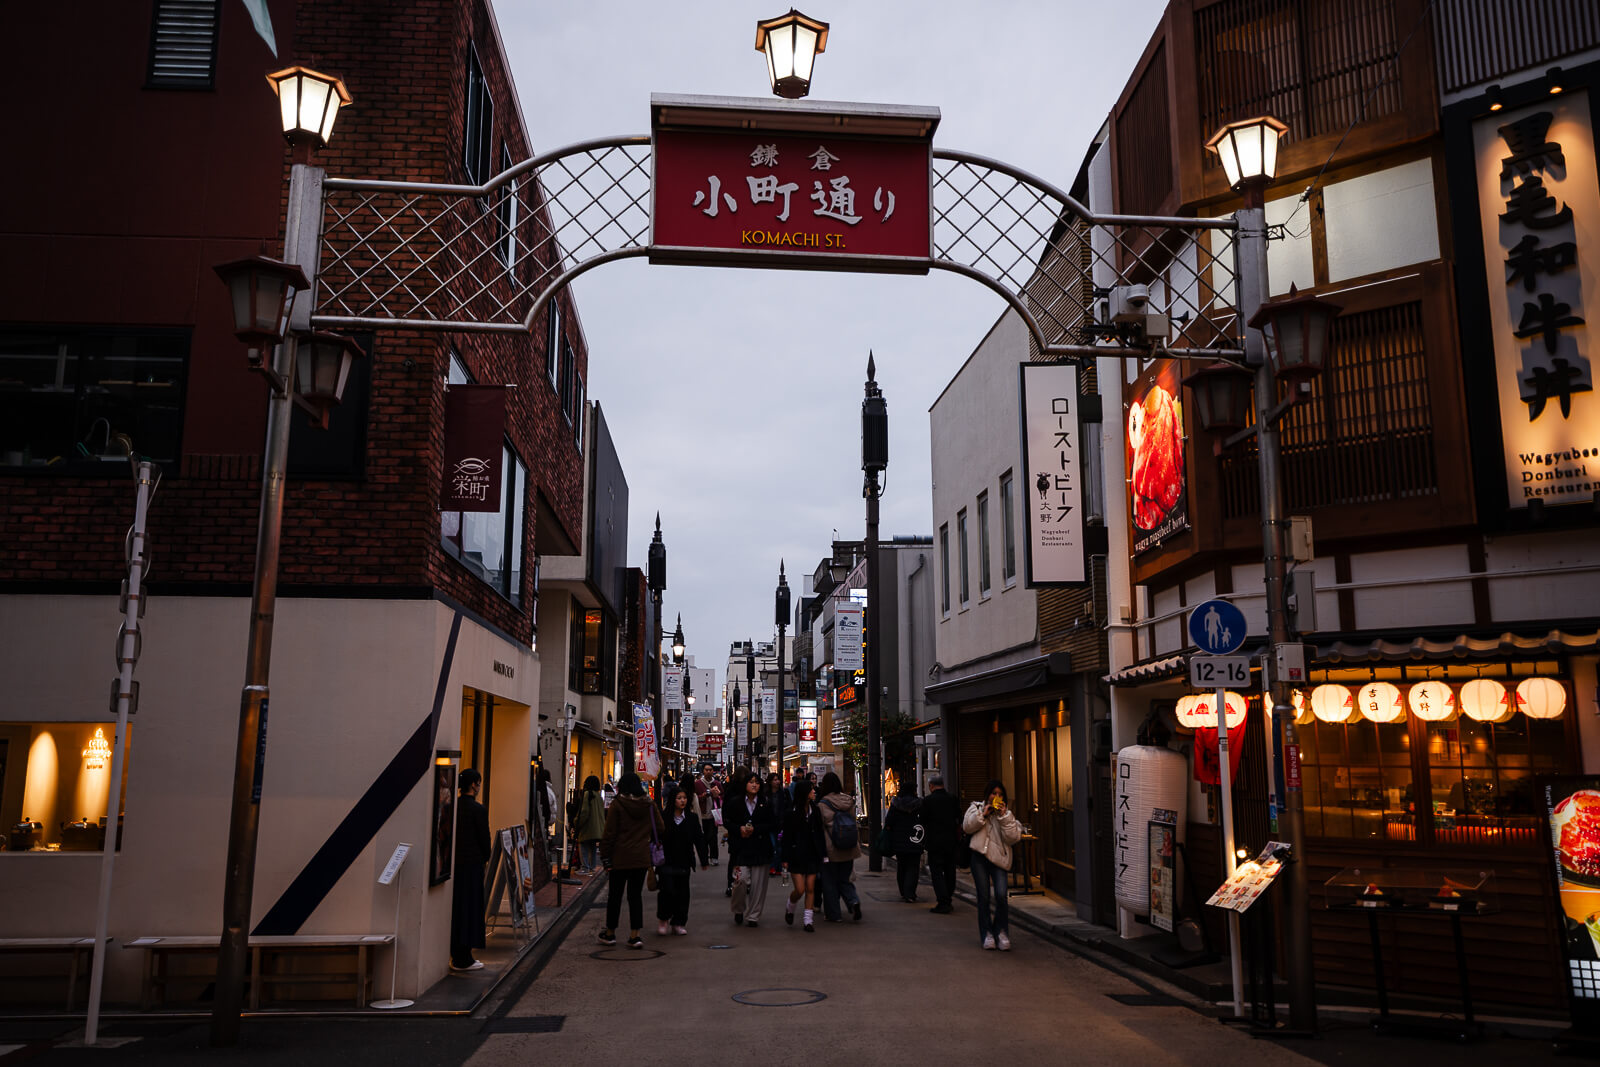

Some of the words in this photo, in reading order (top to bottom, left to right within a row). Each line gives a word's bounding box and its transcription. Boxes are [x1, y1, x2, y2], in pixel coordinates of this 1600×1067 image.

[750, 144, 841, 171] 鎌倉
[693, 175, 896, 225] 小町通り
[742, 230, 819, 247] KOMACHI
[825, 233, 846, 248] ST.
[1052, 398, 1073, 523] ローストビーフ
[1522, 464, 1587, 483] Donburi
[452, 476, 490, 501] 栄町
[1040, 502, 1052, 524] 大野
[1196, 662, 1246, 681] 12-16
[636, 728, 647, 772] クリーム
[644, 722, 656, 758] ソフト
[1119, 762, 1131, 878] ローストビーフ
